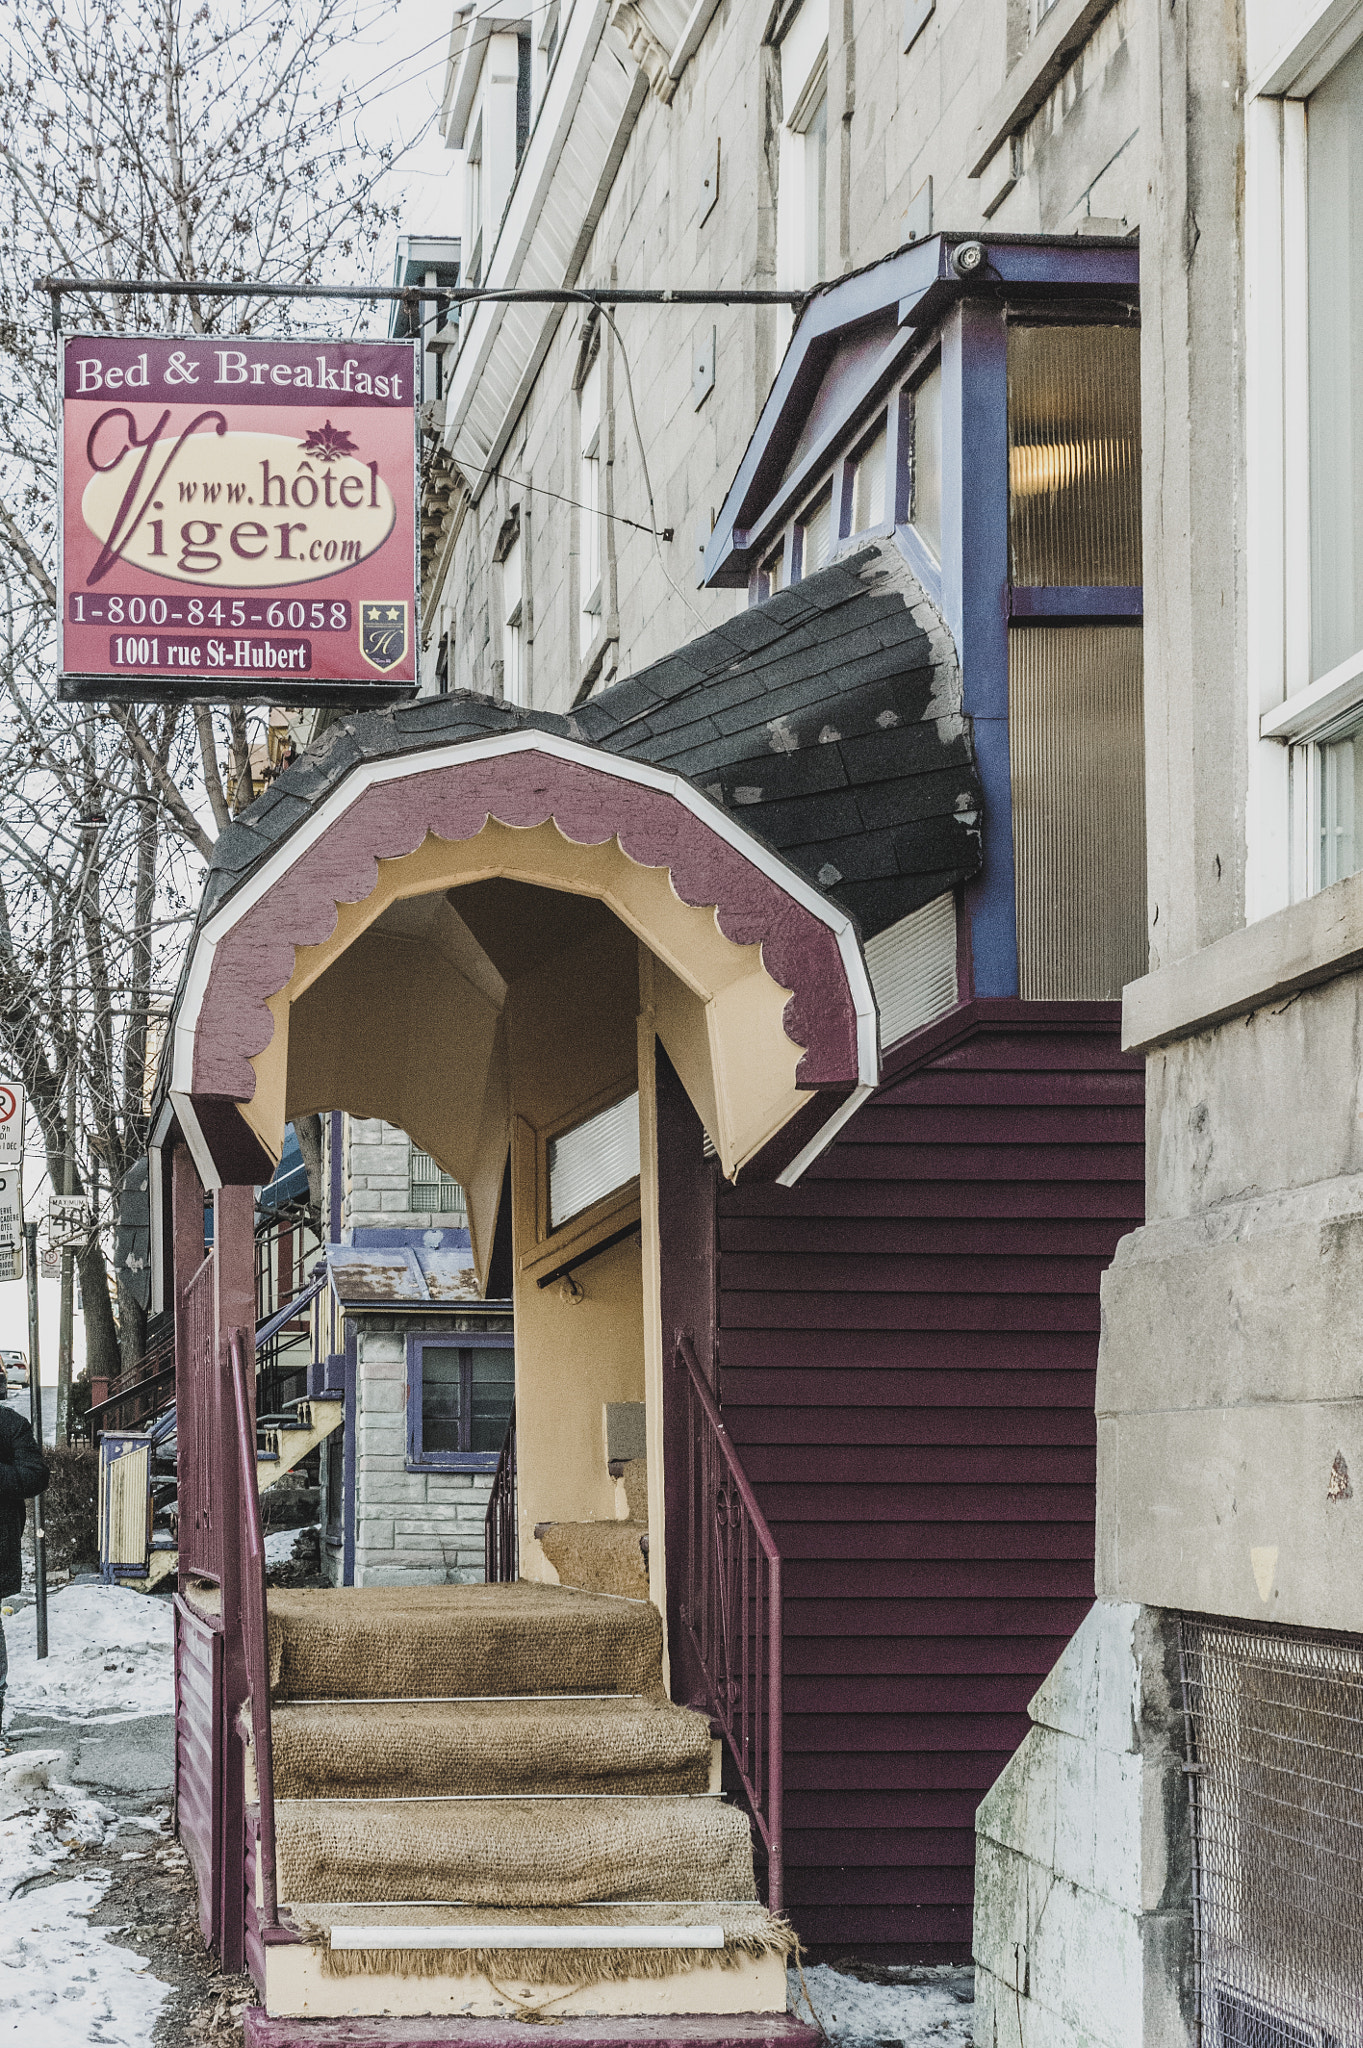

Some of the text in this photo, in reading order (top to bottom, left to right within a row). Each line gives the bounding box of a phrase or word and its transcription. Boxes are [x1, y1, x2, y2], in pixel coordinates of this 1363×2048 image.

[75, 350, 403, 400] Bed & Breakfast
[178, 459, 381, 509] www.hôtel
[73, 595, 347, 629] 1-800-845-6058
[114, 637, 306, 669] 1001 rue St-Hubert
